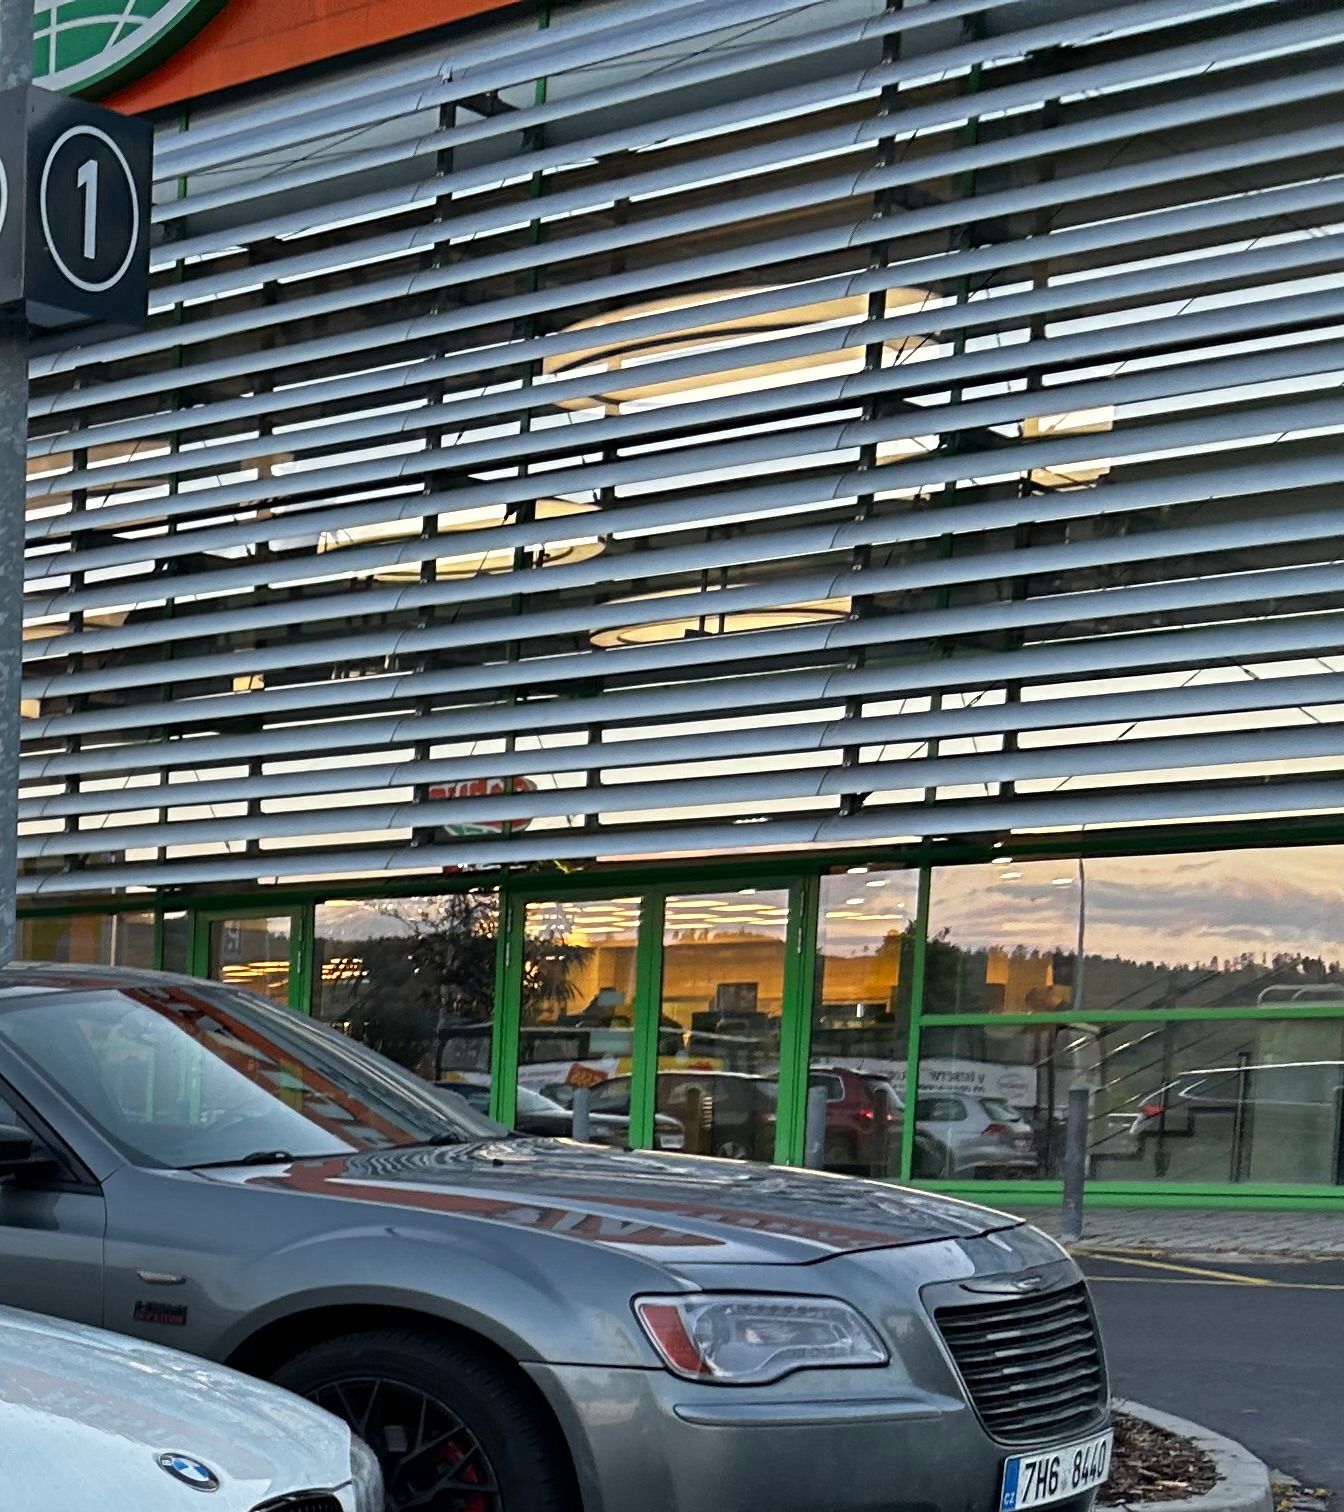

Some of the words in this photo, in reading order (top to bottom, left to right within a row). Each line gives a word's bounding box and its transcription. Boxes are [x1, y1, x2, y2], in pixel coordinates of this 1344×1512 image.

[76, 158, 99, 260] 1
[1004, 1491, 1016, 1505] CZ
[1022, 1455, 1060, 1503] 7H6
[1072, 1439, 1107, 1489] 8440
